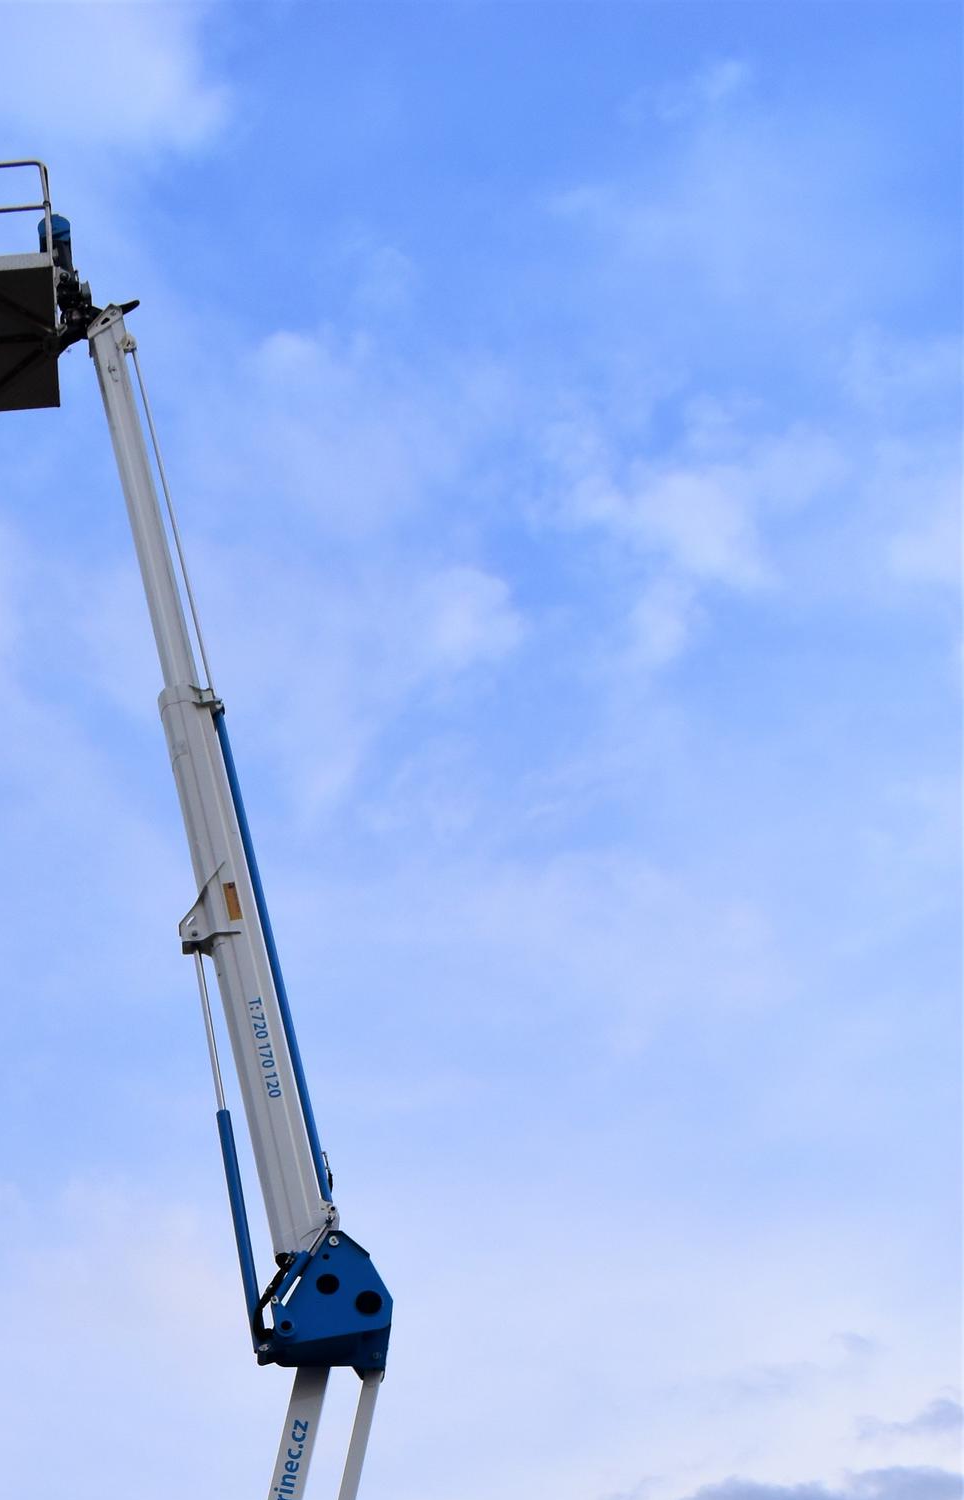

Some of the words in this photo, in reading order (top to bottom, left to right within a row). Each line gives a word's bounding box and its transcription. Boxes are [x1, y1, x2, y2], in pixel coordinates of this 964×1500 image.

[248, 997, 262, 1011] T:
[251, 1012, 269, 1040] 720
[258, 1043, 275, 1069] 170
[265, 1072, 282, 1099] 120
